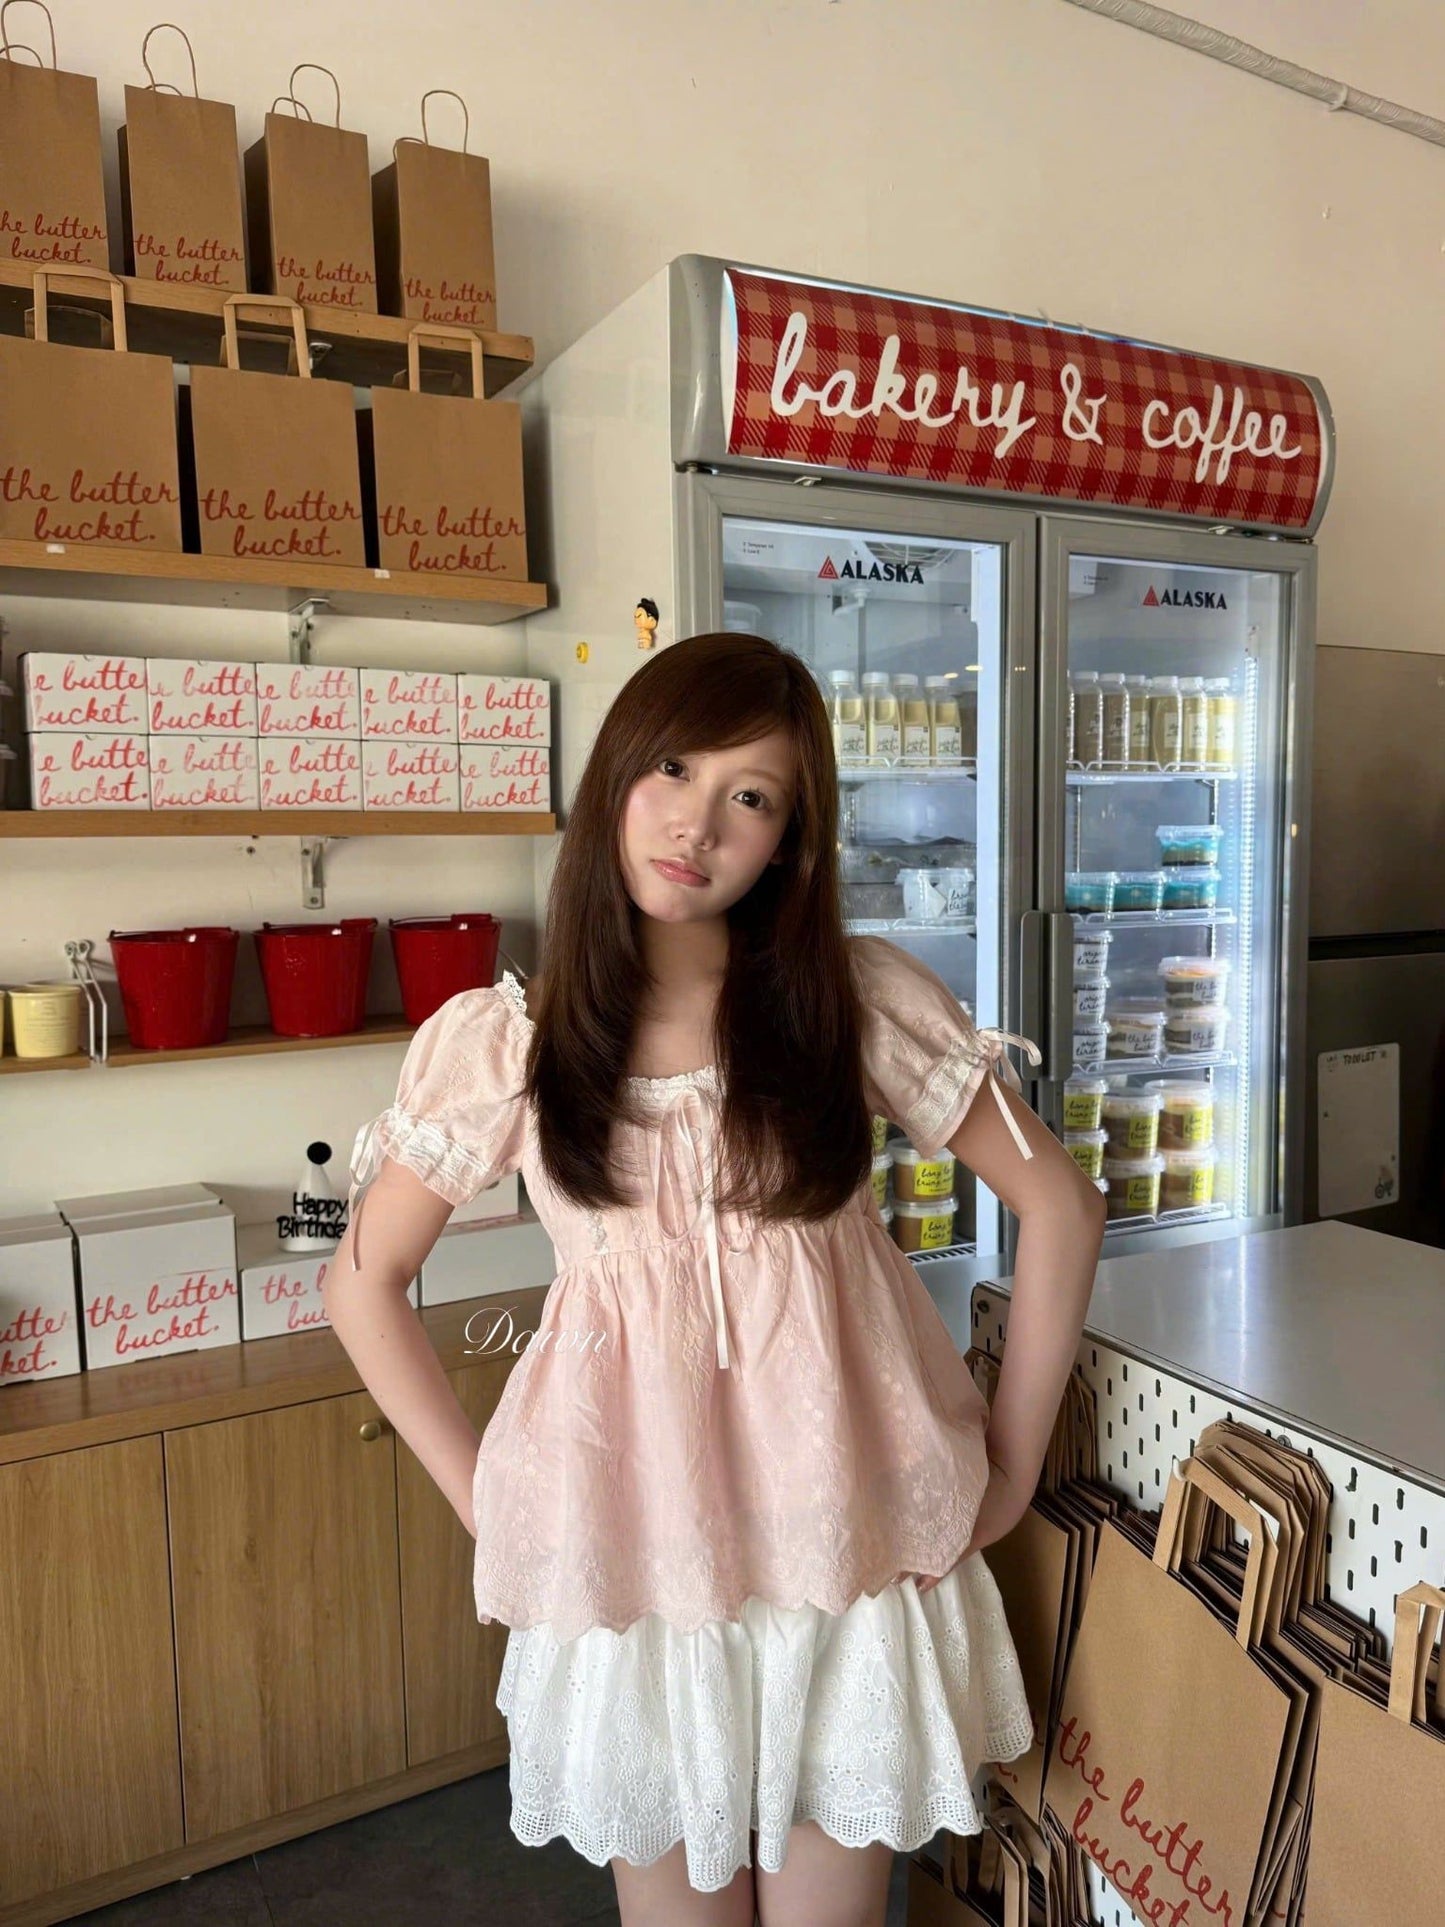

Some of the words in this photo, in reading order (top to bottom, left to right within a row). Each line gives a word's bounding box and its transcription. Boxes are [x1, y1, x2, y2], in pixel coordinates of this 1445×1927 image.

[0, 210, 27, 233] he
[34, 213, 107, 240] butter
[11, 236, 92, 264] bucket.
[133, 233, 170, 257] the
[177, 237, 245, 262] butter
[155, 260, 229, 286] bucket.
[277, 256, 311, 280] the
[315, 260, 376, 285] butter
[296, 281, 363, 307] bucket.
[404, 278, 434, 300] the
[440, 281, 496, 304] butter
[422, 302, 485, 326] bucket.
[771, 311, 1037, 459] bakery
[1060, 362, 1109, 447] &
[1142, 384, 1302, 486] coffee
[0, 468, 60, 503] the
[70, 469, 179, 504] butter
[203, 489, 255, 522] the
[263, 489, 362, 522] butter
[34, 507, 156, 542] bucket.
[380, 505, 429, 537] the
[437, 506, 526, 539] butter
[234, 526, 341, 557] bucket.
[409, 540, 506, 572] bucket.
[841, 559, 925, 586] ALASKA
[1160, 588, 1227, 610] ALASKA
[62, 660, 147, 691] butte
[183, 666, 256, 697] butte
[388, 675, 457, 704] butte
[485, 683, 549, 710] butte
[151, 699, 254, 731] bucket.
[261, 701, 357, 733] bucket.
[461, 712, 544, 740] bucket.
[71, 738, 149, 770] butte
[184, 741, 256, 773] butte
[290, 745, 360, 772] butte
[388, 748, 459, 775] butte
[490, 750, 549, 777] butte
[39, 771, 147, 806] bucket.
[261, 774, 357, 806] bucket.
[293, 1191, 349, 1219] Happy
[277, 1215, 348, 1239] Birthda
[86, 1294, 138, 1328] the
[146, 1274, 238, 1315] butter
[260, 1274, 308, 1304] the
[115, 1305, 219, 1355] bucket.
[0, 1340, 57, 1376] ket.
[1056, 1716, 1110, 1801] the
[1120, 1777, 1234, 1927] butter
